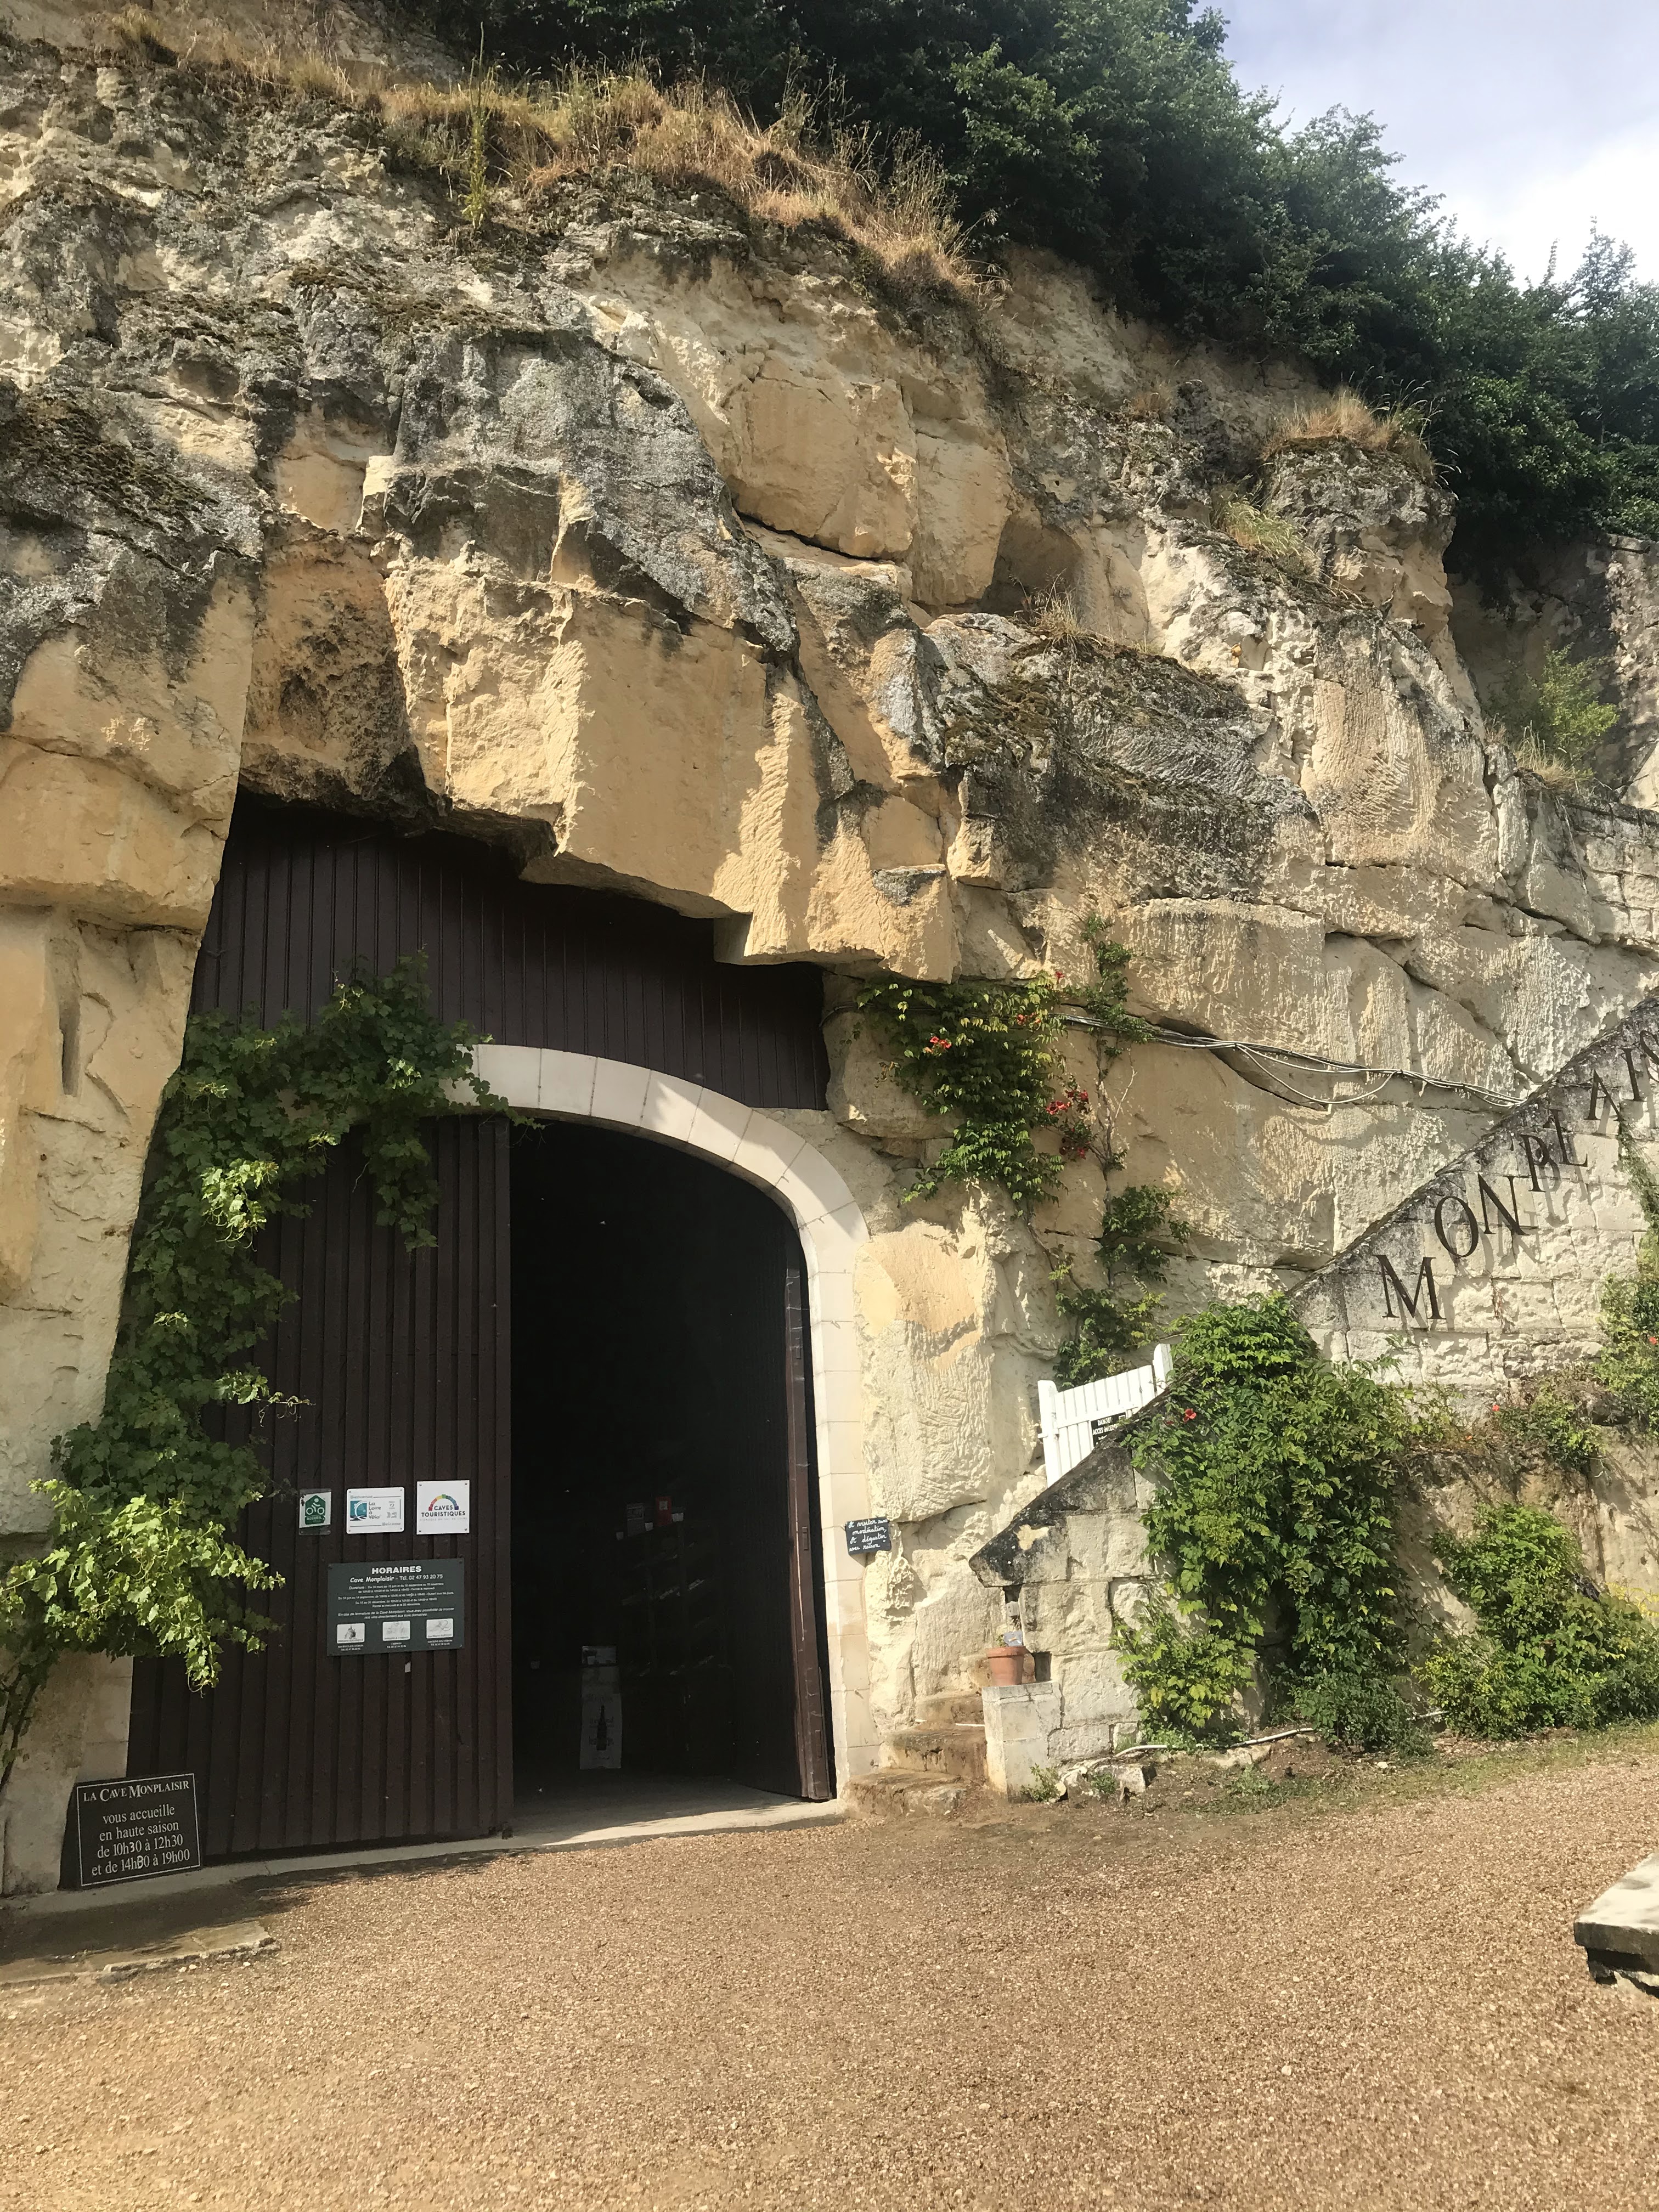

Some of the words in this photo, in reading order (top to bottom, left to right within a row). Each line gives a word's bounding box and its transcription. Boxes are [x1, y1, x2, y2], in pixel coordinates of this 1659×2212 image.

[857, 1519, 877, 1527] visiter
[861, 1532, 887, 1545] déguster
[372, 1566, 422, 1574] HORAIRES
[83, 1792, 97, 1802] LA
[100, 1788, 127, 1802] CAVE
[128, 1780, 190, 1798] MONPLAISIR
[103, 1813, 127, 1825] vous
[130, 1803, 175, 1821] accueille
[99, 1831, 112, 1842] en
[116, 1826, 144, 1839] haute
[148, 1820, 179, 1835] saison
[97, 1845, 110, 1858] de
[113, 1840, 142, 1856] 10h30
[145, 1838, 150, 1851] à
[154, 1833, 183, 1849] 12h30
[92, 1864, 101, 1876] et
[105, 1860, 118, 1874] de
[153, 1853, 159, 1866] à
[162, 1848, 190, 1864] 19h00
